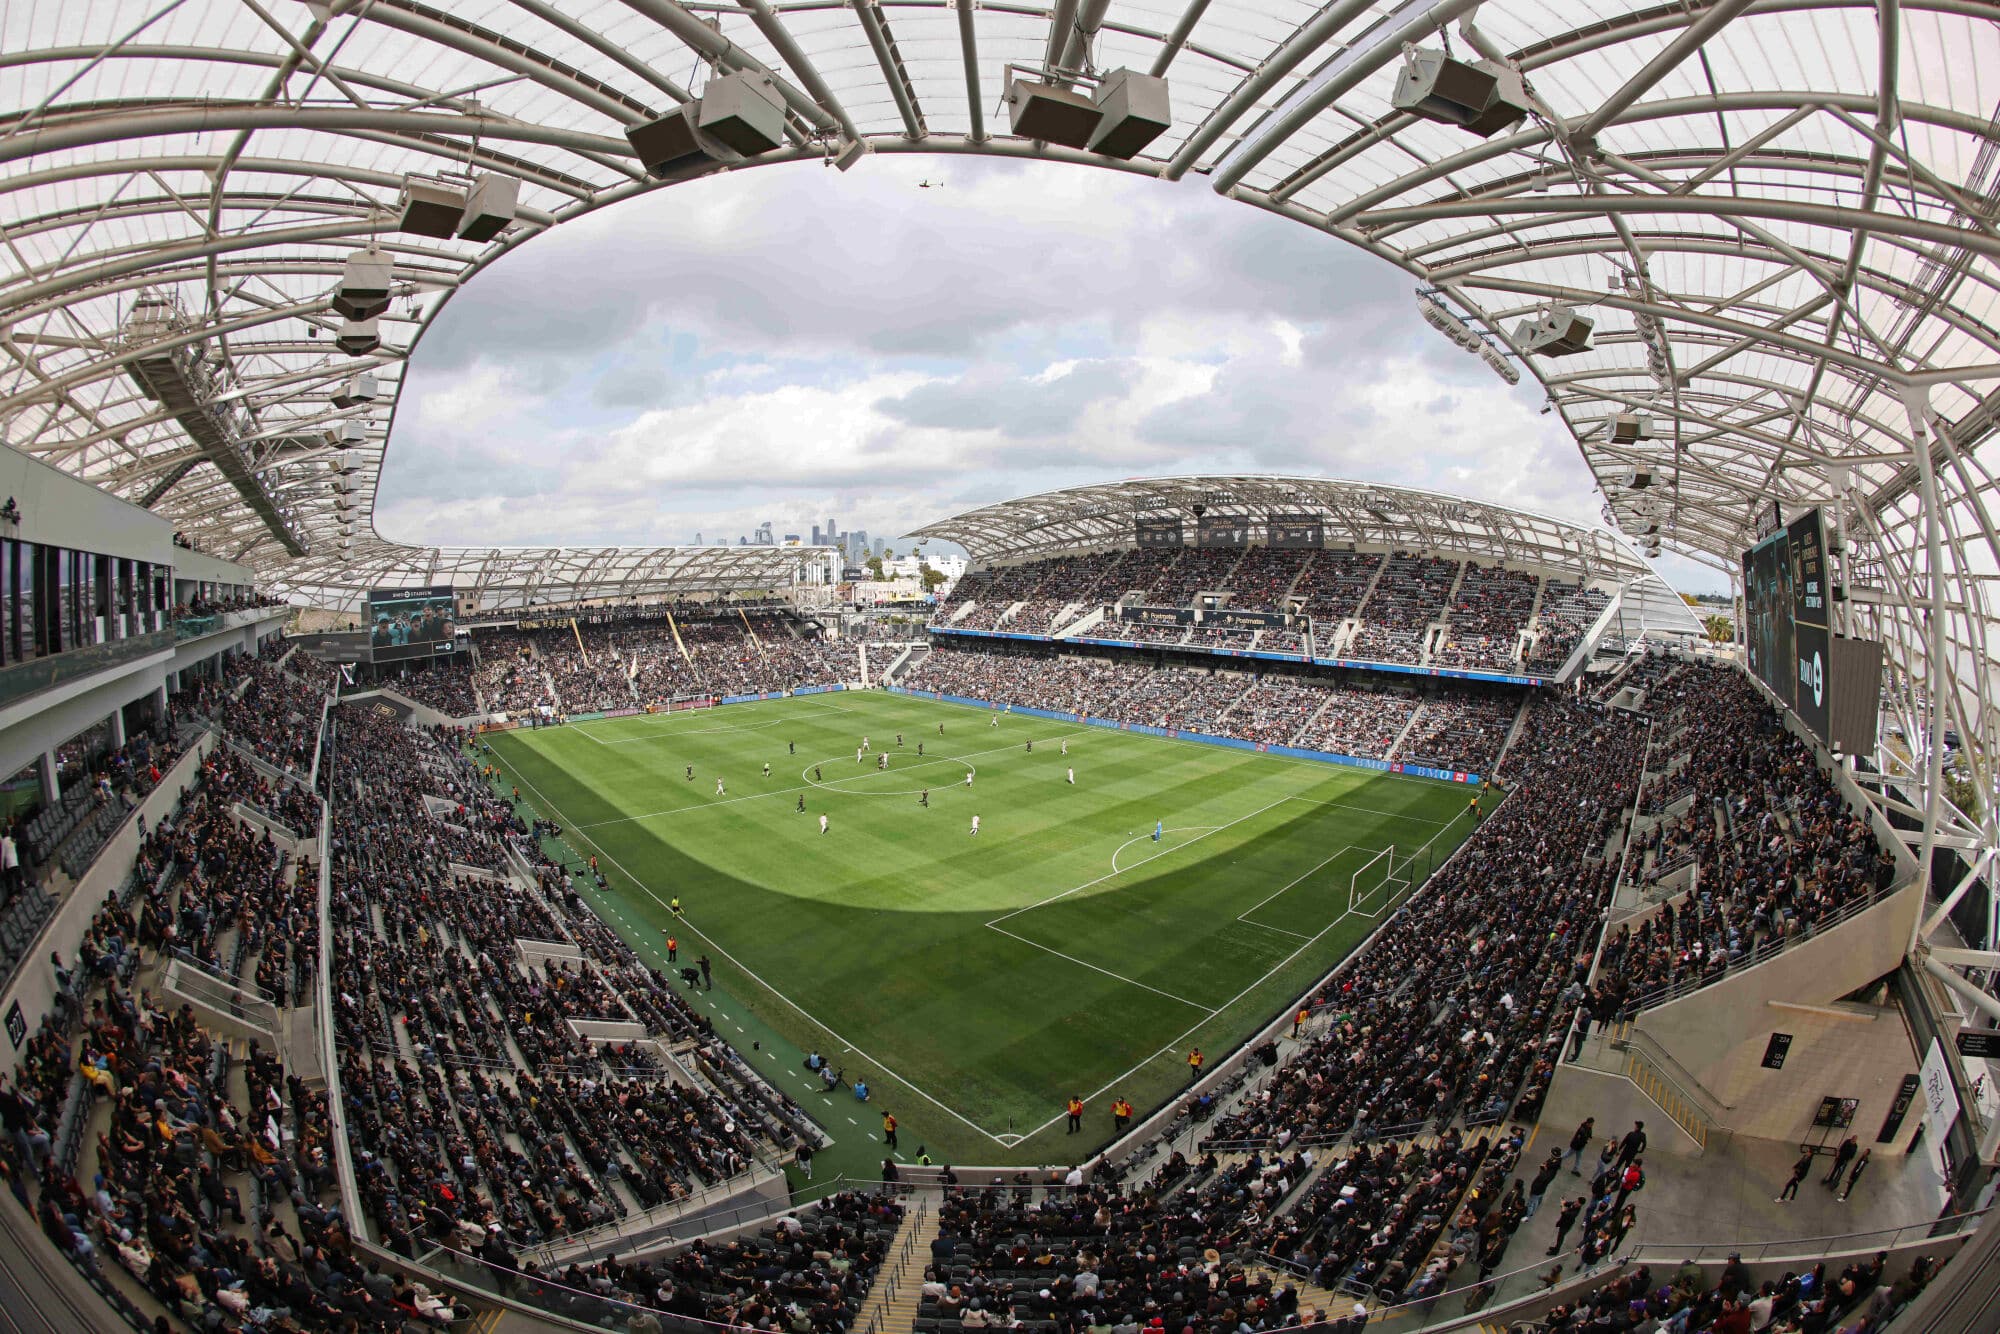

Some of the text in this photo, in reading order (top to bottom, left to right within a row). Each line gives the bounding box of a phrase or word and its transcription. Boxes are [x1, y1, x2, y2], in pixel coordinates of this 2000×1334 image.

[1150, 612, 1177, 620] Postmates
[1800, 658, 1812, 687] BMO
[1355, 758, 1386, 770] BMO
[1417, 766, 1450, 780] BMO
